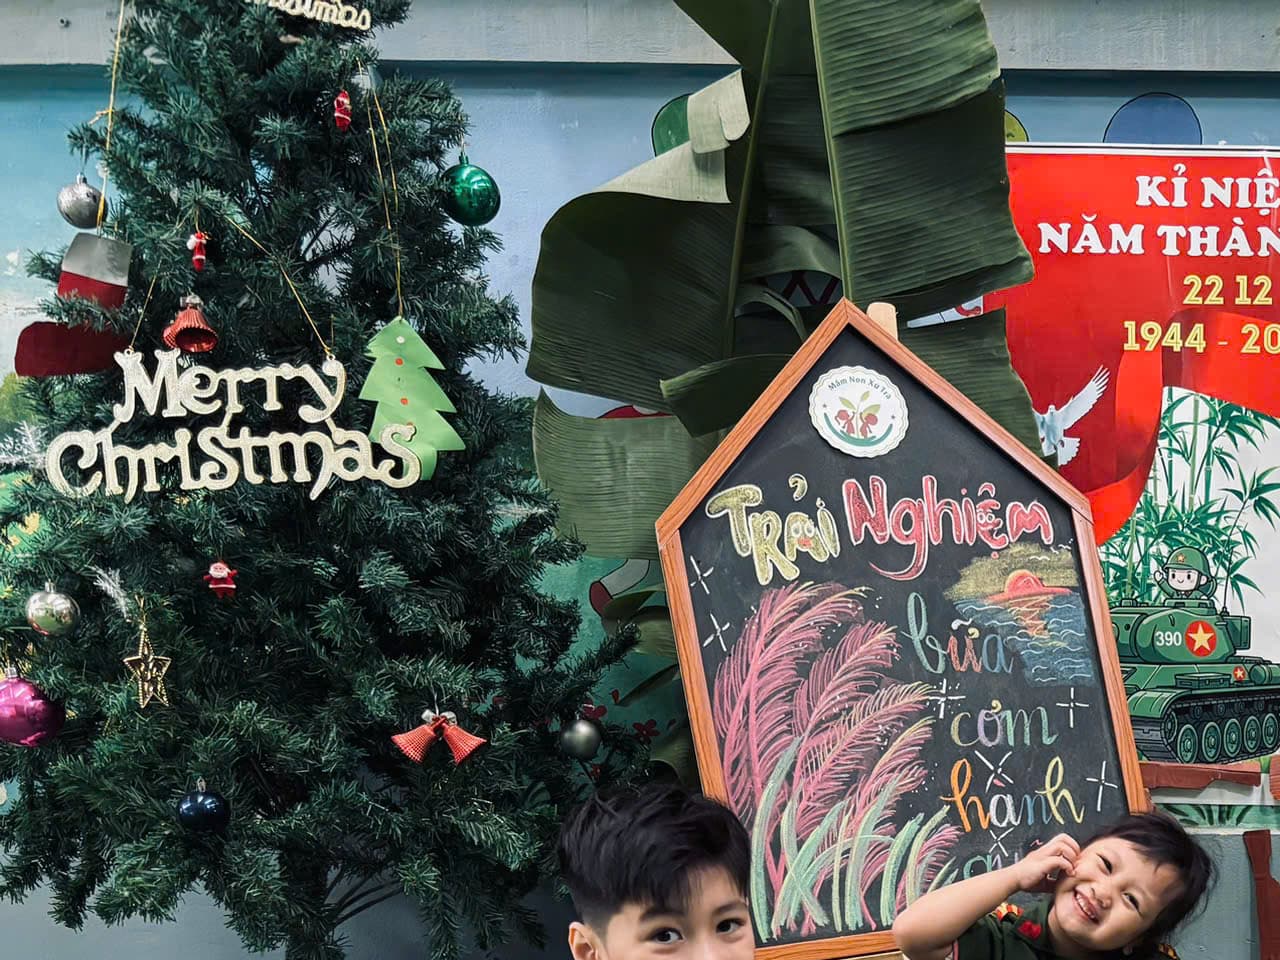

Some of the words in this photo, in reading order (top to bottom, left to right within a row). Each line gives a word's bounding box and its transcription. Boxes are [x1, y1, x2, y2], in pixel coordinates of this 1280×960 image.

[1135, 163, 1189, 208] KỈ
[1037, 213, 1146, 256] NĂM
[1182, 275, 1225, 306] 22
[1234, 275, 1274, 306] 12
[1122, 320, 1207, 353] 1944
[114, 349, 345, 424] Merry
[849, 376, 866, 385] Non
[45, 423, 423, 502] Christmas
[842, 475, 1054, 581] Nghiệm
[900, 592, 1014, 674] bữa
[1155, 631, 1182, 647] 390
[951, 699, 1058, 747] cơm
[939, 755, 1085, 832] hành
